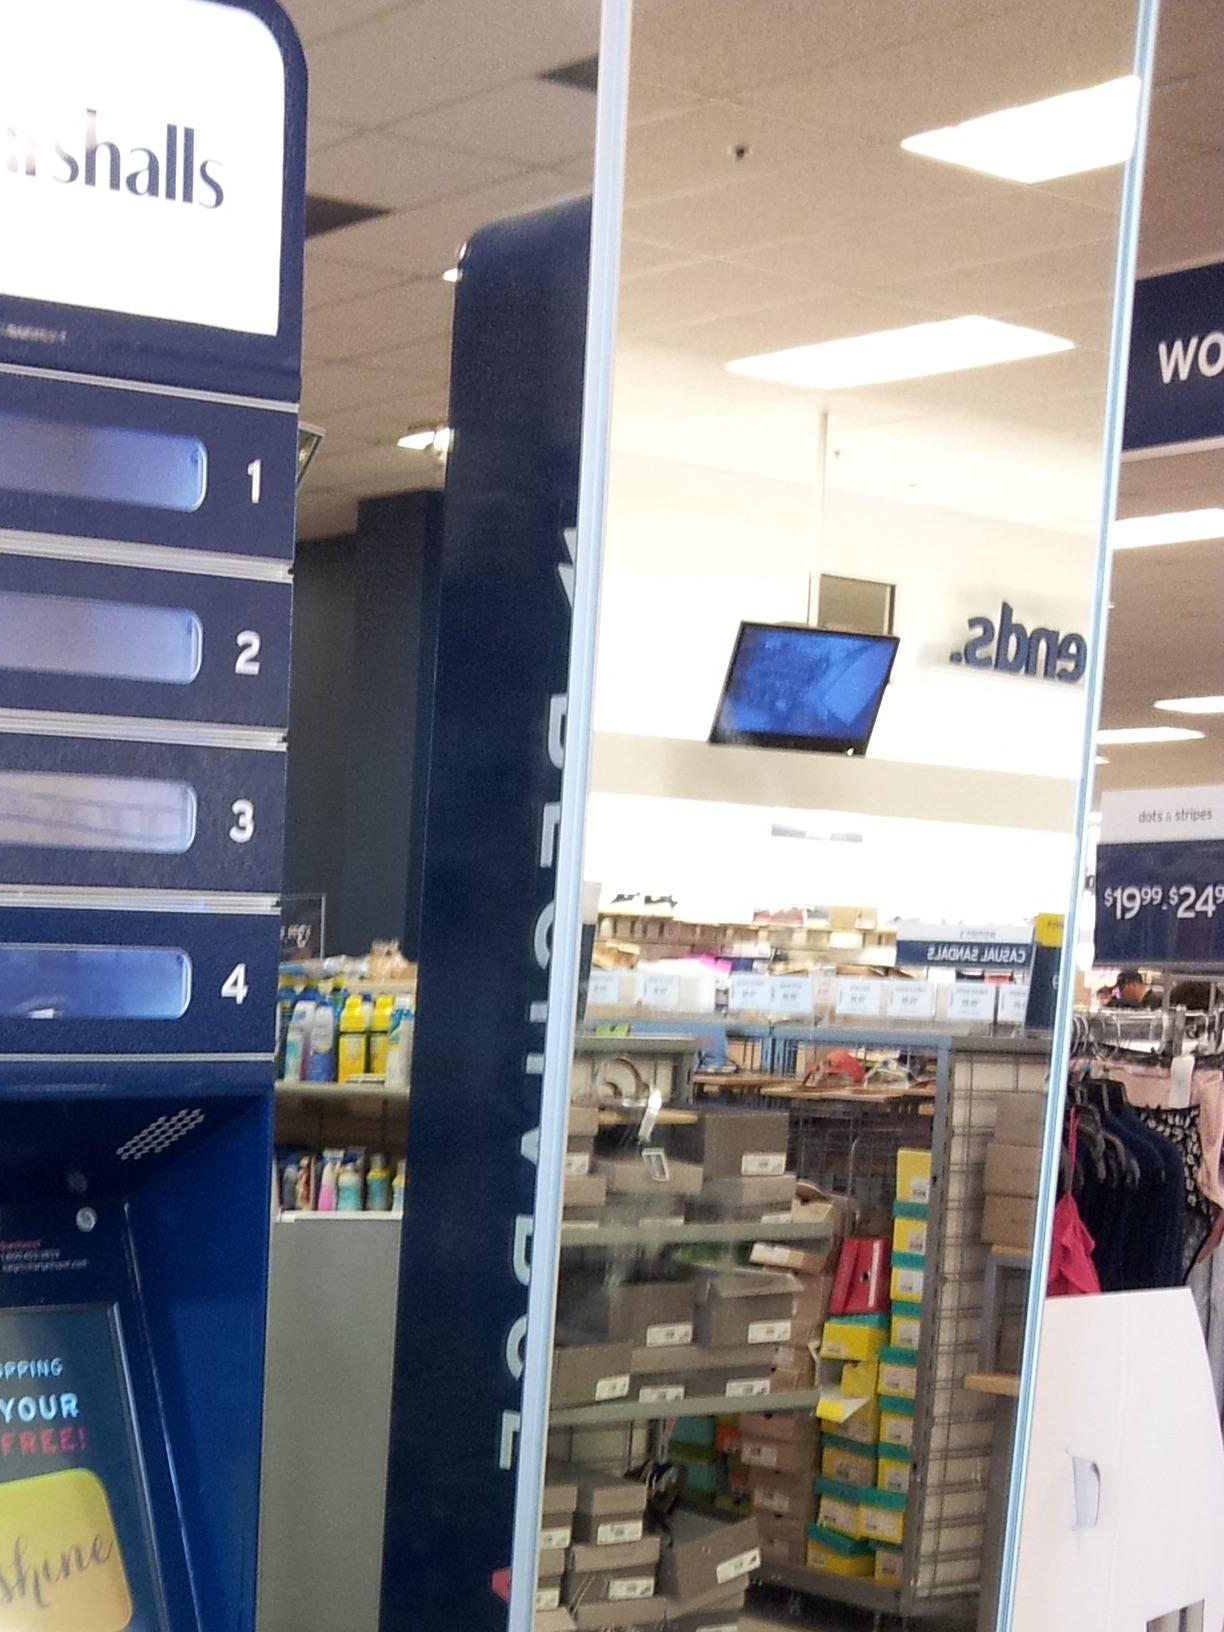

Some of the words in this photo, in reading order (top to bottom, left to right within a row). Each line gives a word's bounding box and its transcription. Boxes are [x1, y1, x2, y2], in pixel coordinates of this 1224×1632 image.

[247, 459, 262, 504] 1
[234, 630, 261, 676] 2
[229, 798, 255, 843] 3
[1138, 810, 1163, 824] dots
[1175, 807, 1213, 823] stripes
[220, 962, 248, 1005] 4
[0, 1426, 87, 1456] FREE!
